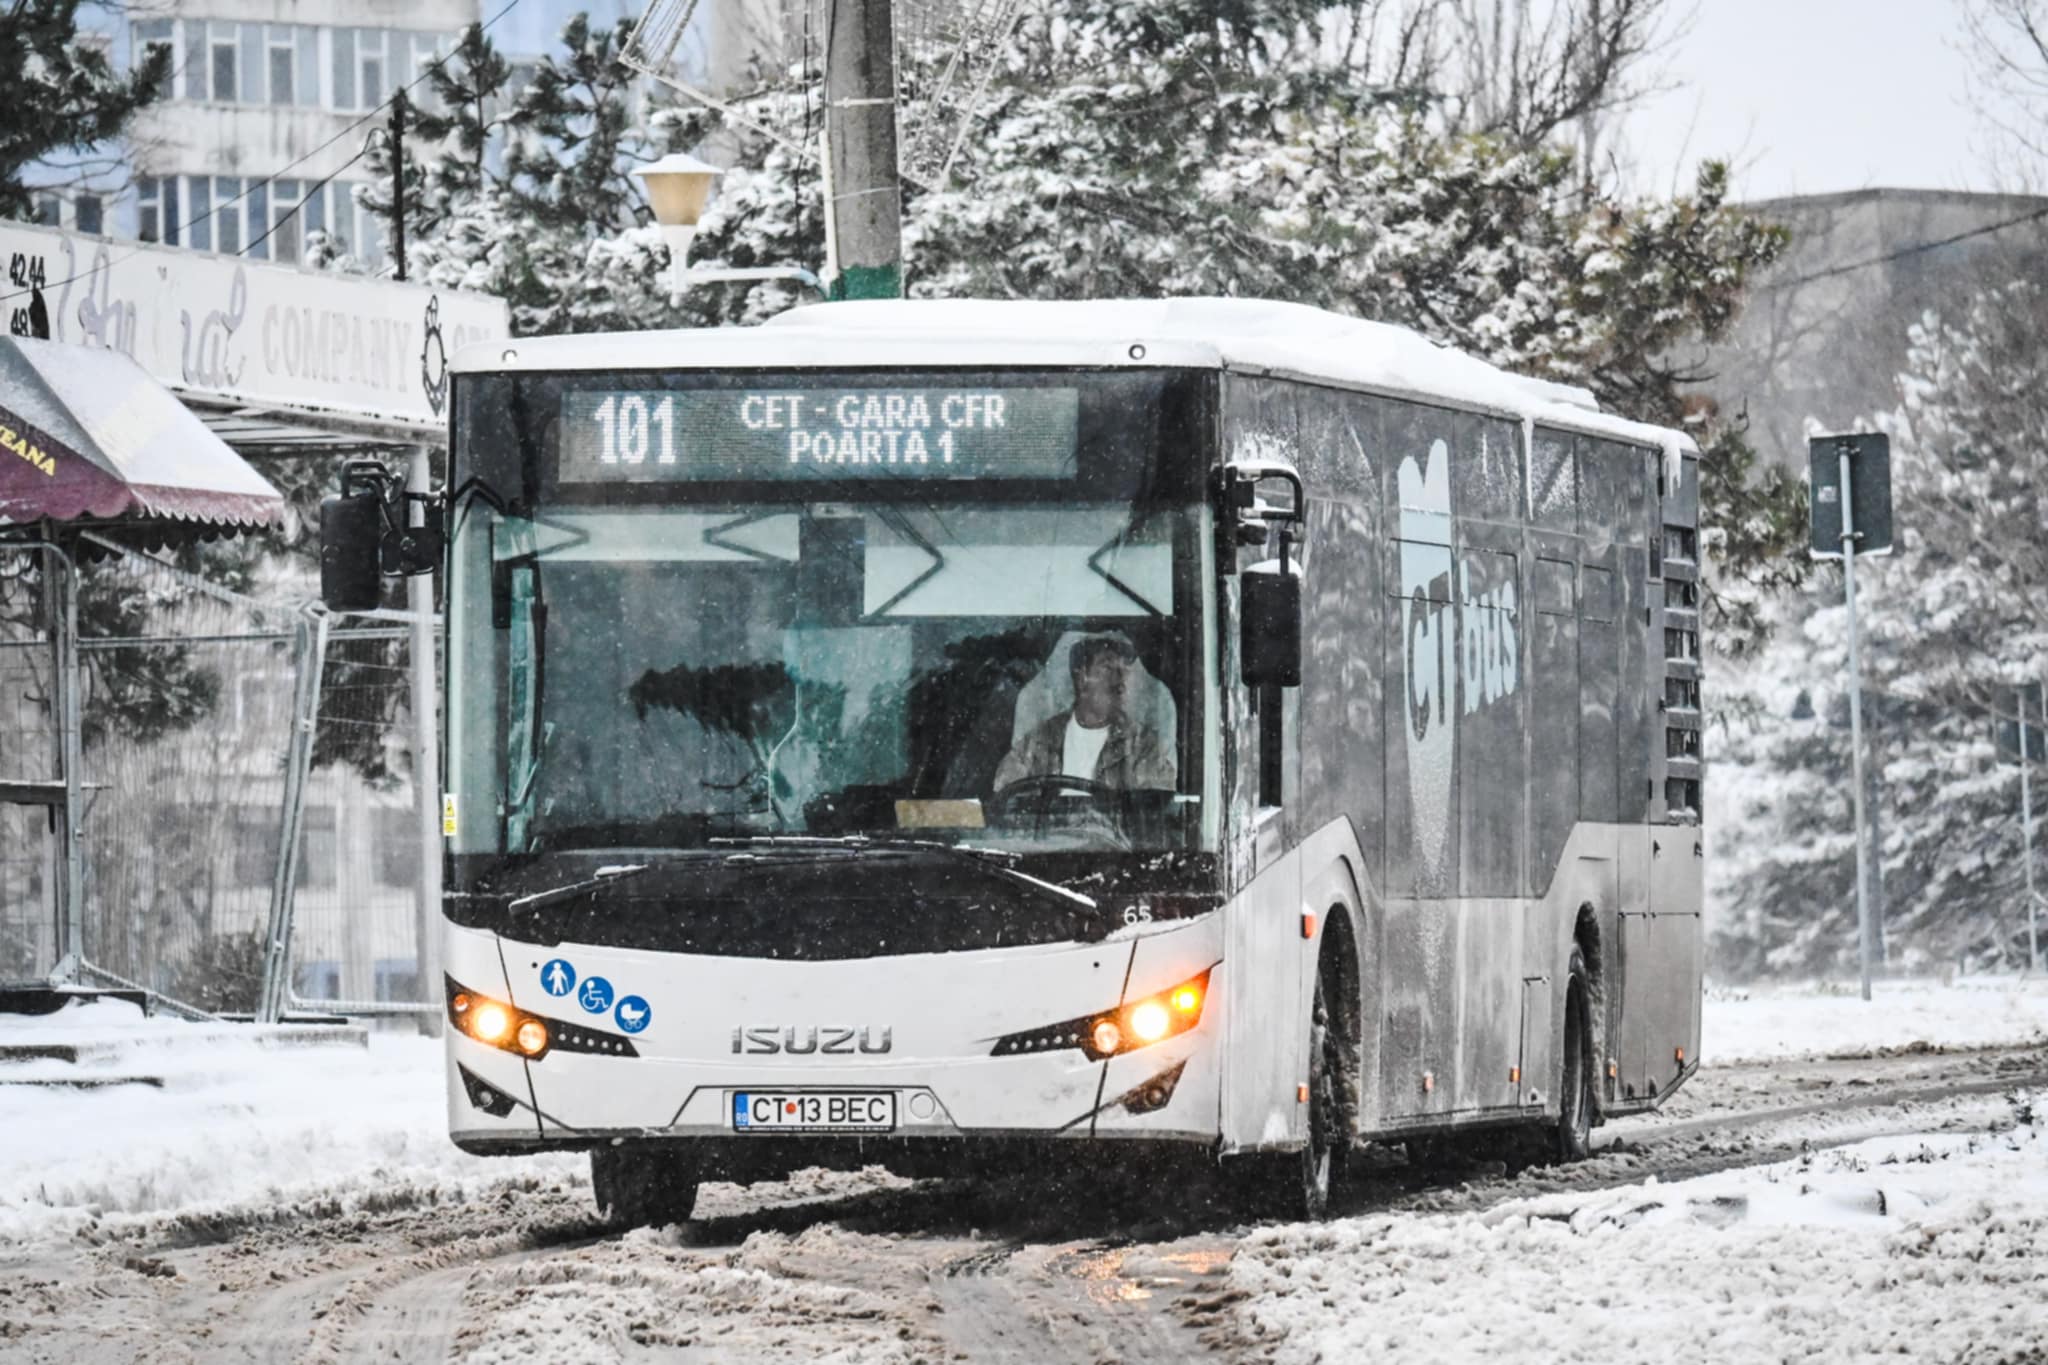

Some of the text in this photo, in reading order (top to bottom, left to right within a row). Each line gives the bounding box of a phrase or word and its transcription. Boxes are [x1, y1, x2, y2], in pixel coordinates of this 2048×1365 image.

[262, 303, 411, 393] COMPANY
[594, 395, 676, 464] 101
[740, 395, 804, 429] CET
[836, 395, 931, 428] GARA
[940, 395, 1005, 428] CFR
[789, 431, 954, 463] POARTA 1
[0, 425, 55, 477] EANA
[731, 1025, 892, 1055] ISUZU
[753, 1098, 787, 1123] CT
[797, 1097, 821, 1123] 13
[828, 1097, 886, 1123] BEC
